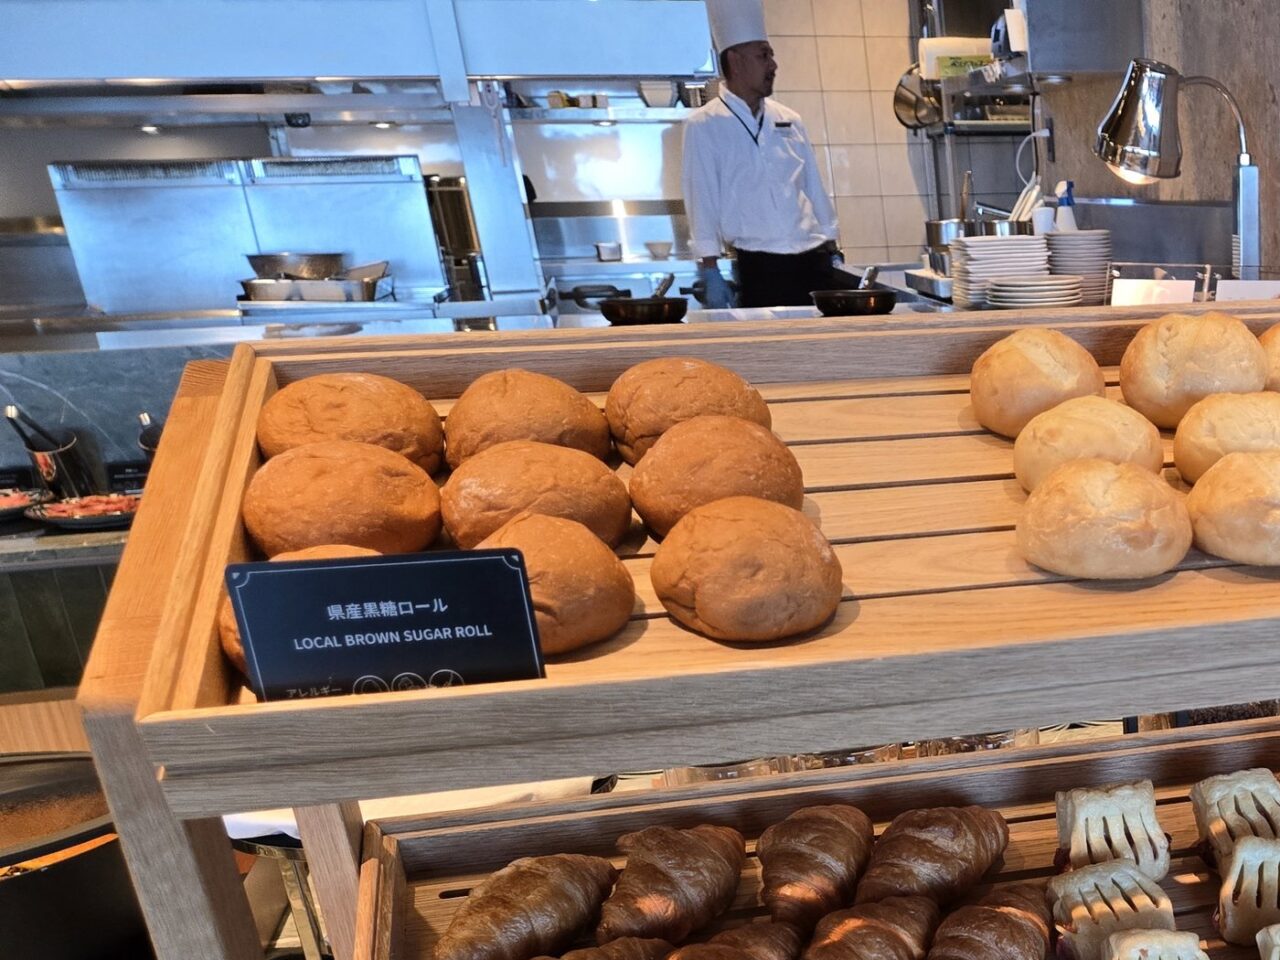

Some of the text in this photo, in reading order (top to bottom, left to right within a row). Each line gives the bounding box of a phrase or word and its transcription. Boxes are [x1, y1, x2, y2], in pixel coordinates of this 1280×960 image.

[327, 598, 448, 621] 県産黒糖ロール
[294, 624, 492, 650] LOCAL BROWN SUGAR ROLL
[286, 684, 342, 698] アレルギー
